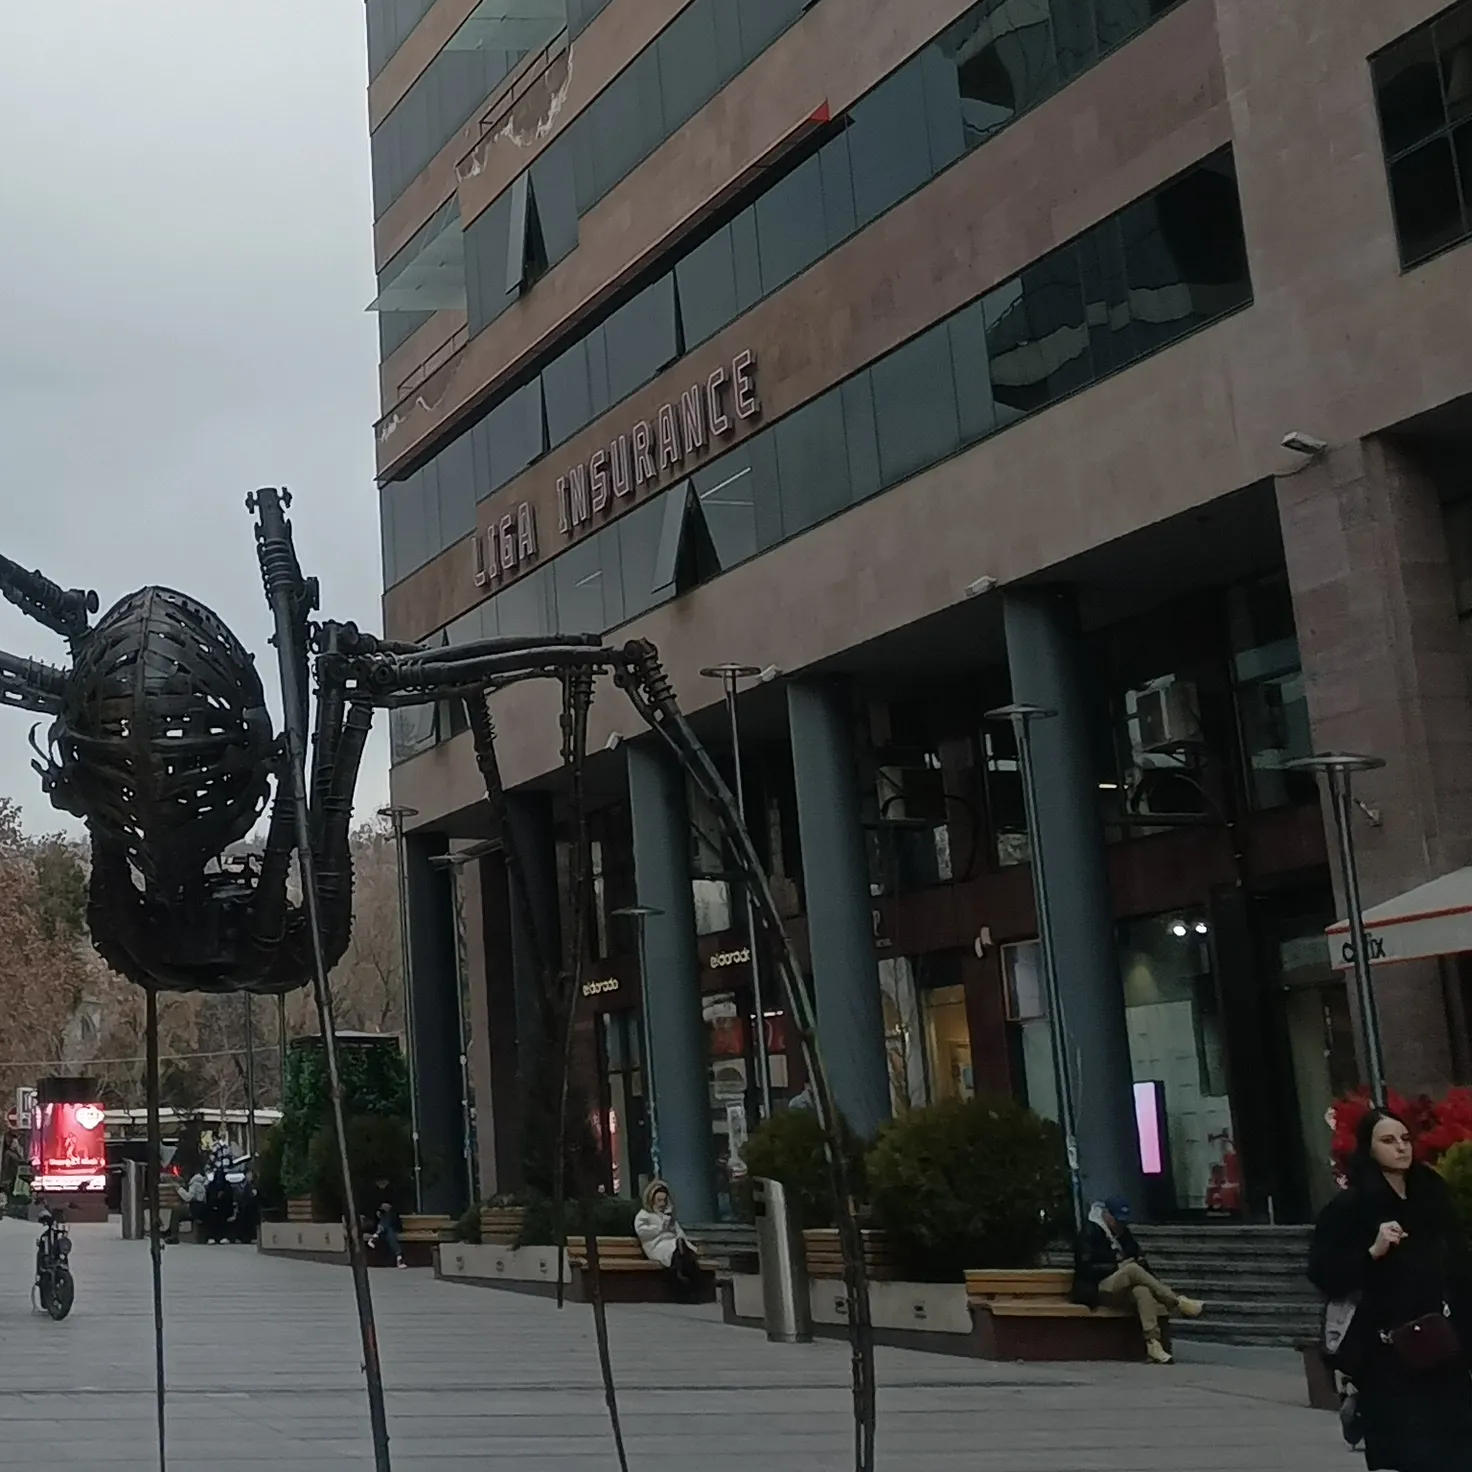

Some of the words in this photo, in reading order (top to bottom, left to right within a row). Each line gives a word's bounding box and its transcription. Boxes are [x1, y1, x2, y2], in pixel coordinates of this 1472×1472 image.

[471, 502, 537, 588] LIGA
[556, 349, 759, 534] INSURANCE
[581, 977, 620, 997] eldorado
